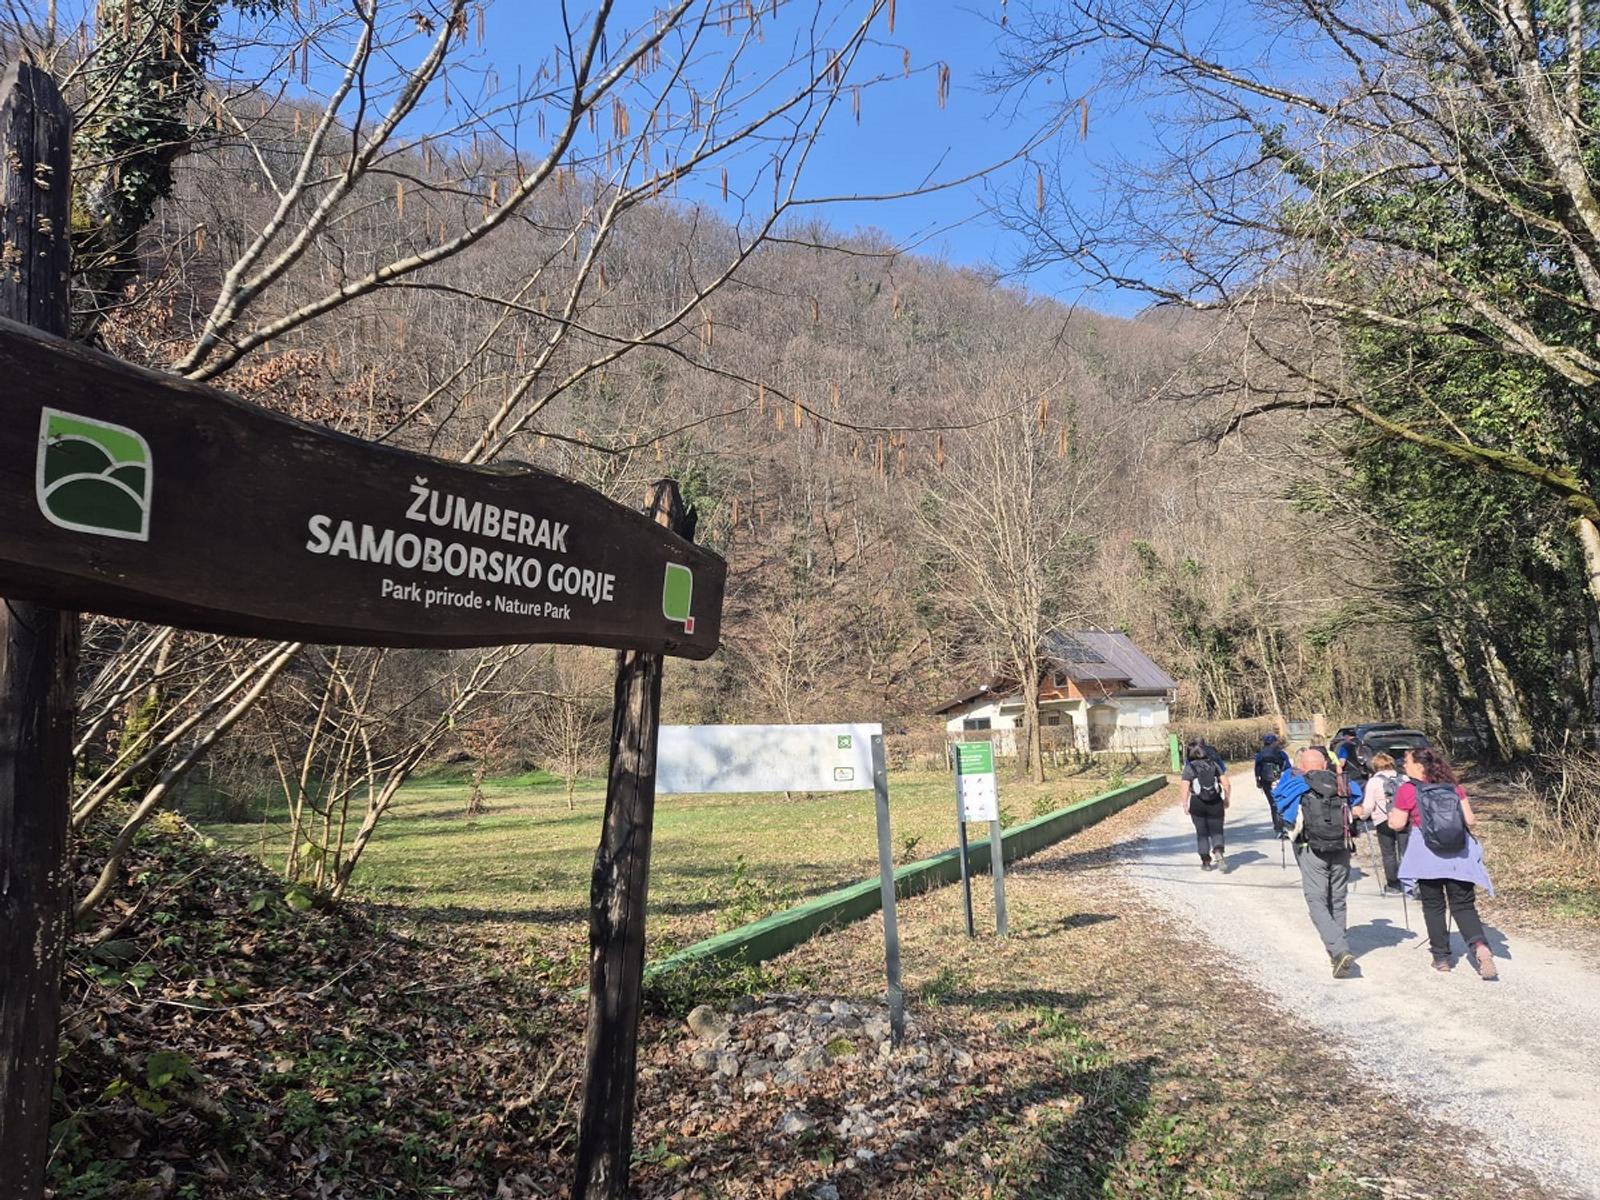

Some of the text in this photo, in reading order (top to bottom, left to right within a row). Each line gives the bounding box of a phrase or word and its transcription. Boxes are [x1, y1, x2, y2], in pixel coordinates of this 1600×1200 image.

[405, 475, 570, 554] ŽUMBERAK
[306, 514, 616, 605] SAMOBORSKO GORJE
[381, 579, 571, 621] Park prirode Nature Park
